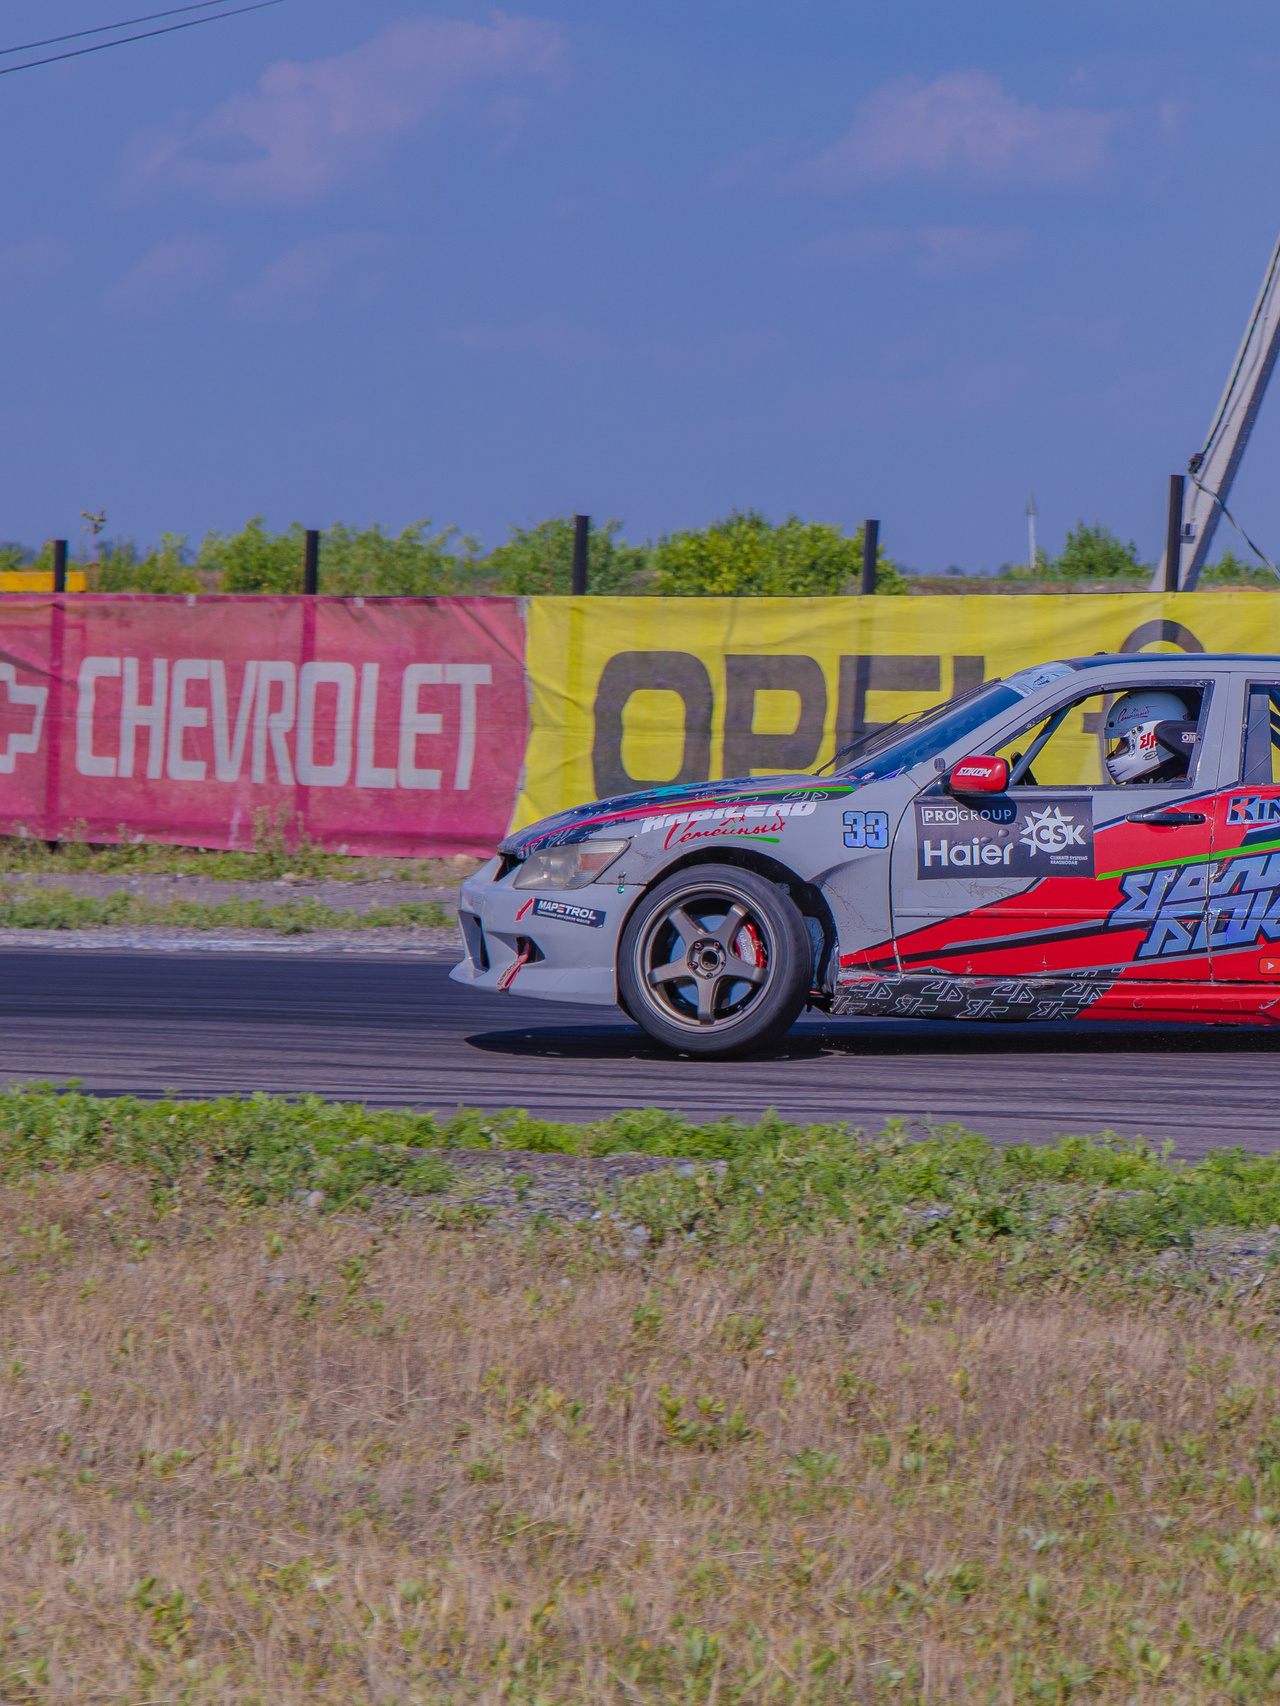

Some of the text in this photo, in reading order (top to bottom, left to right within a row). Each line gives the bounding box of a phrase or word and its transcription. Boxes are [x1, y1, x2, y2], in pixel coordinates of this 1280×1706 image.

[76, 656, 493, 790] CHEVROLET
[592, 650, 986, 800] OPE
[843, 811, 888, 848] 33
[1034, 824, 1087, 845] CSK
[923, 838, 1014, 867] Haier
[538, 900, 597, 920] MAPETROL
